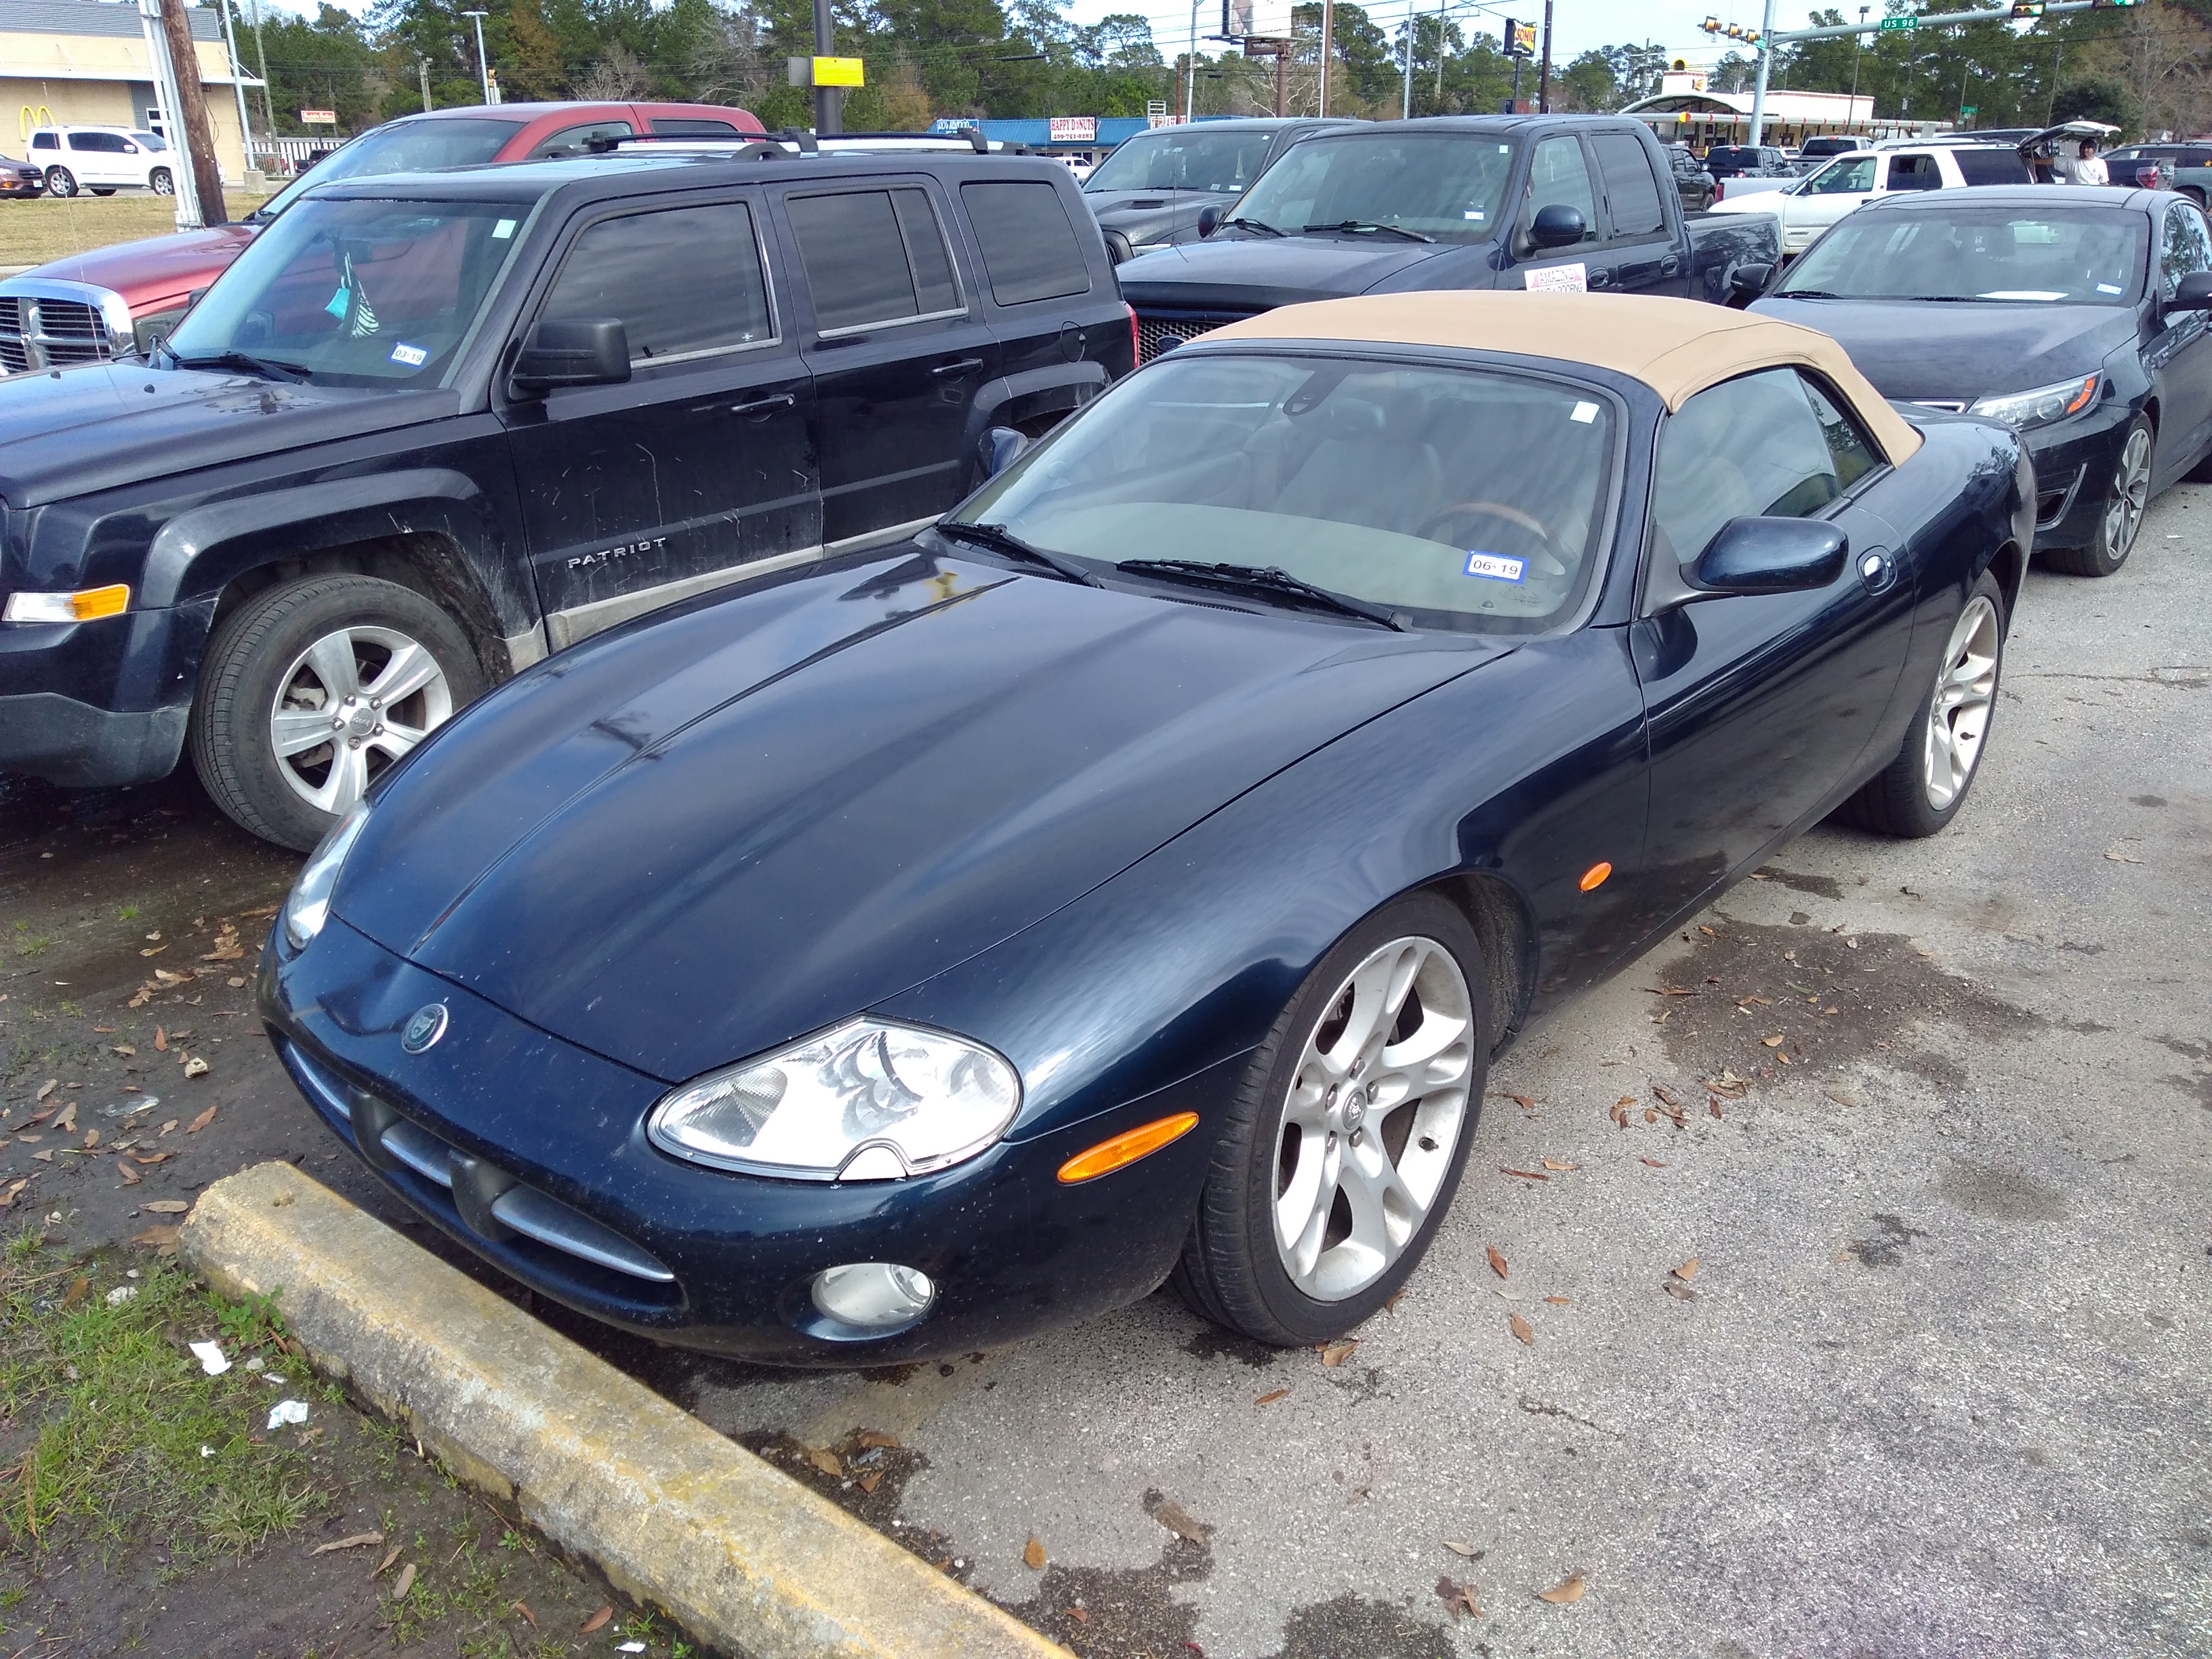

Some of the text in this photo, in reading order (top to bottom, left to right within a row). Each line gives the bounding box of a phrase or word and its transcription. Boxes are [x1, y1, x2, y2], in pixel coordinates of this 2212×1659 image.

[1884, 19, 1914, 28] US 96
[1515, 28, 1535, 43] SONIC
[1051, 118, 1095, 131] HAPPY DONUTS
[1539, 268, 1574, 285] AMAZING
[567, 537, 667, 569] PATRIOT
